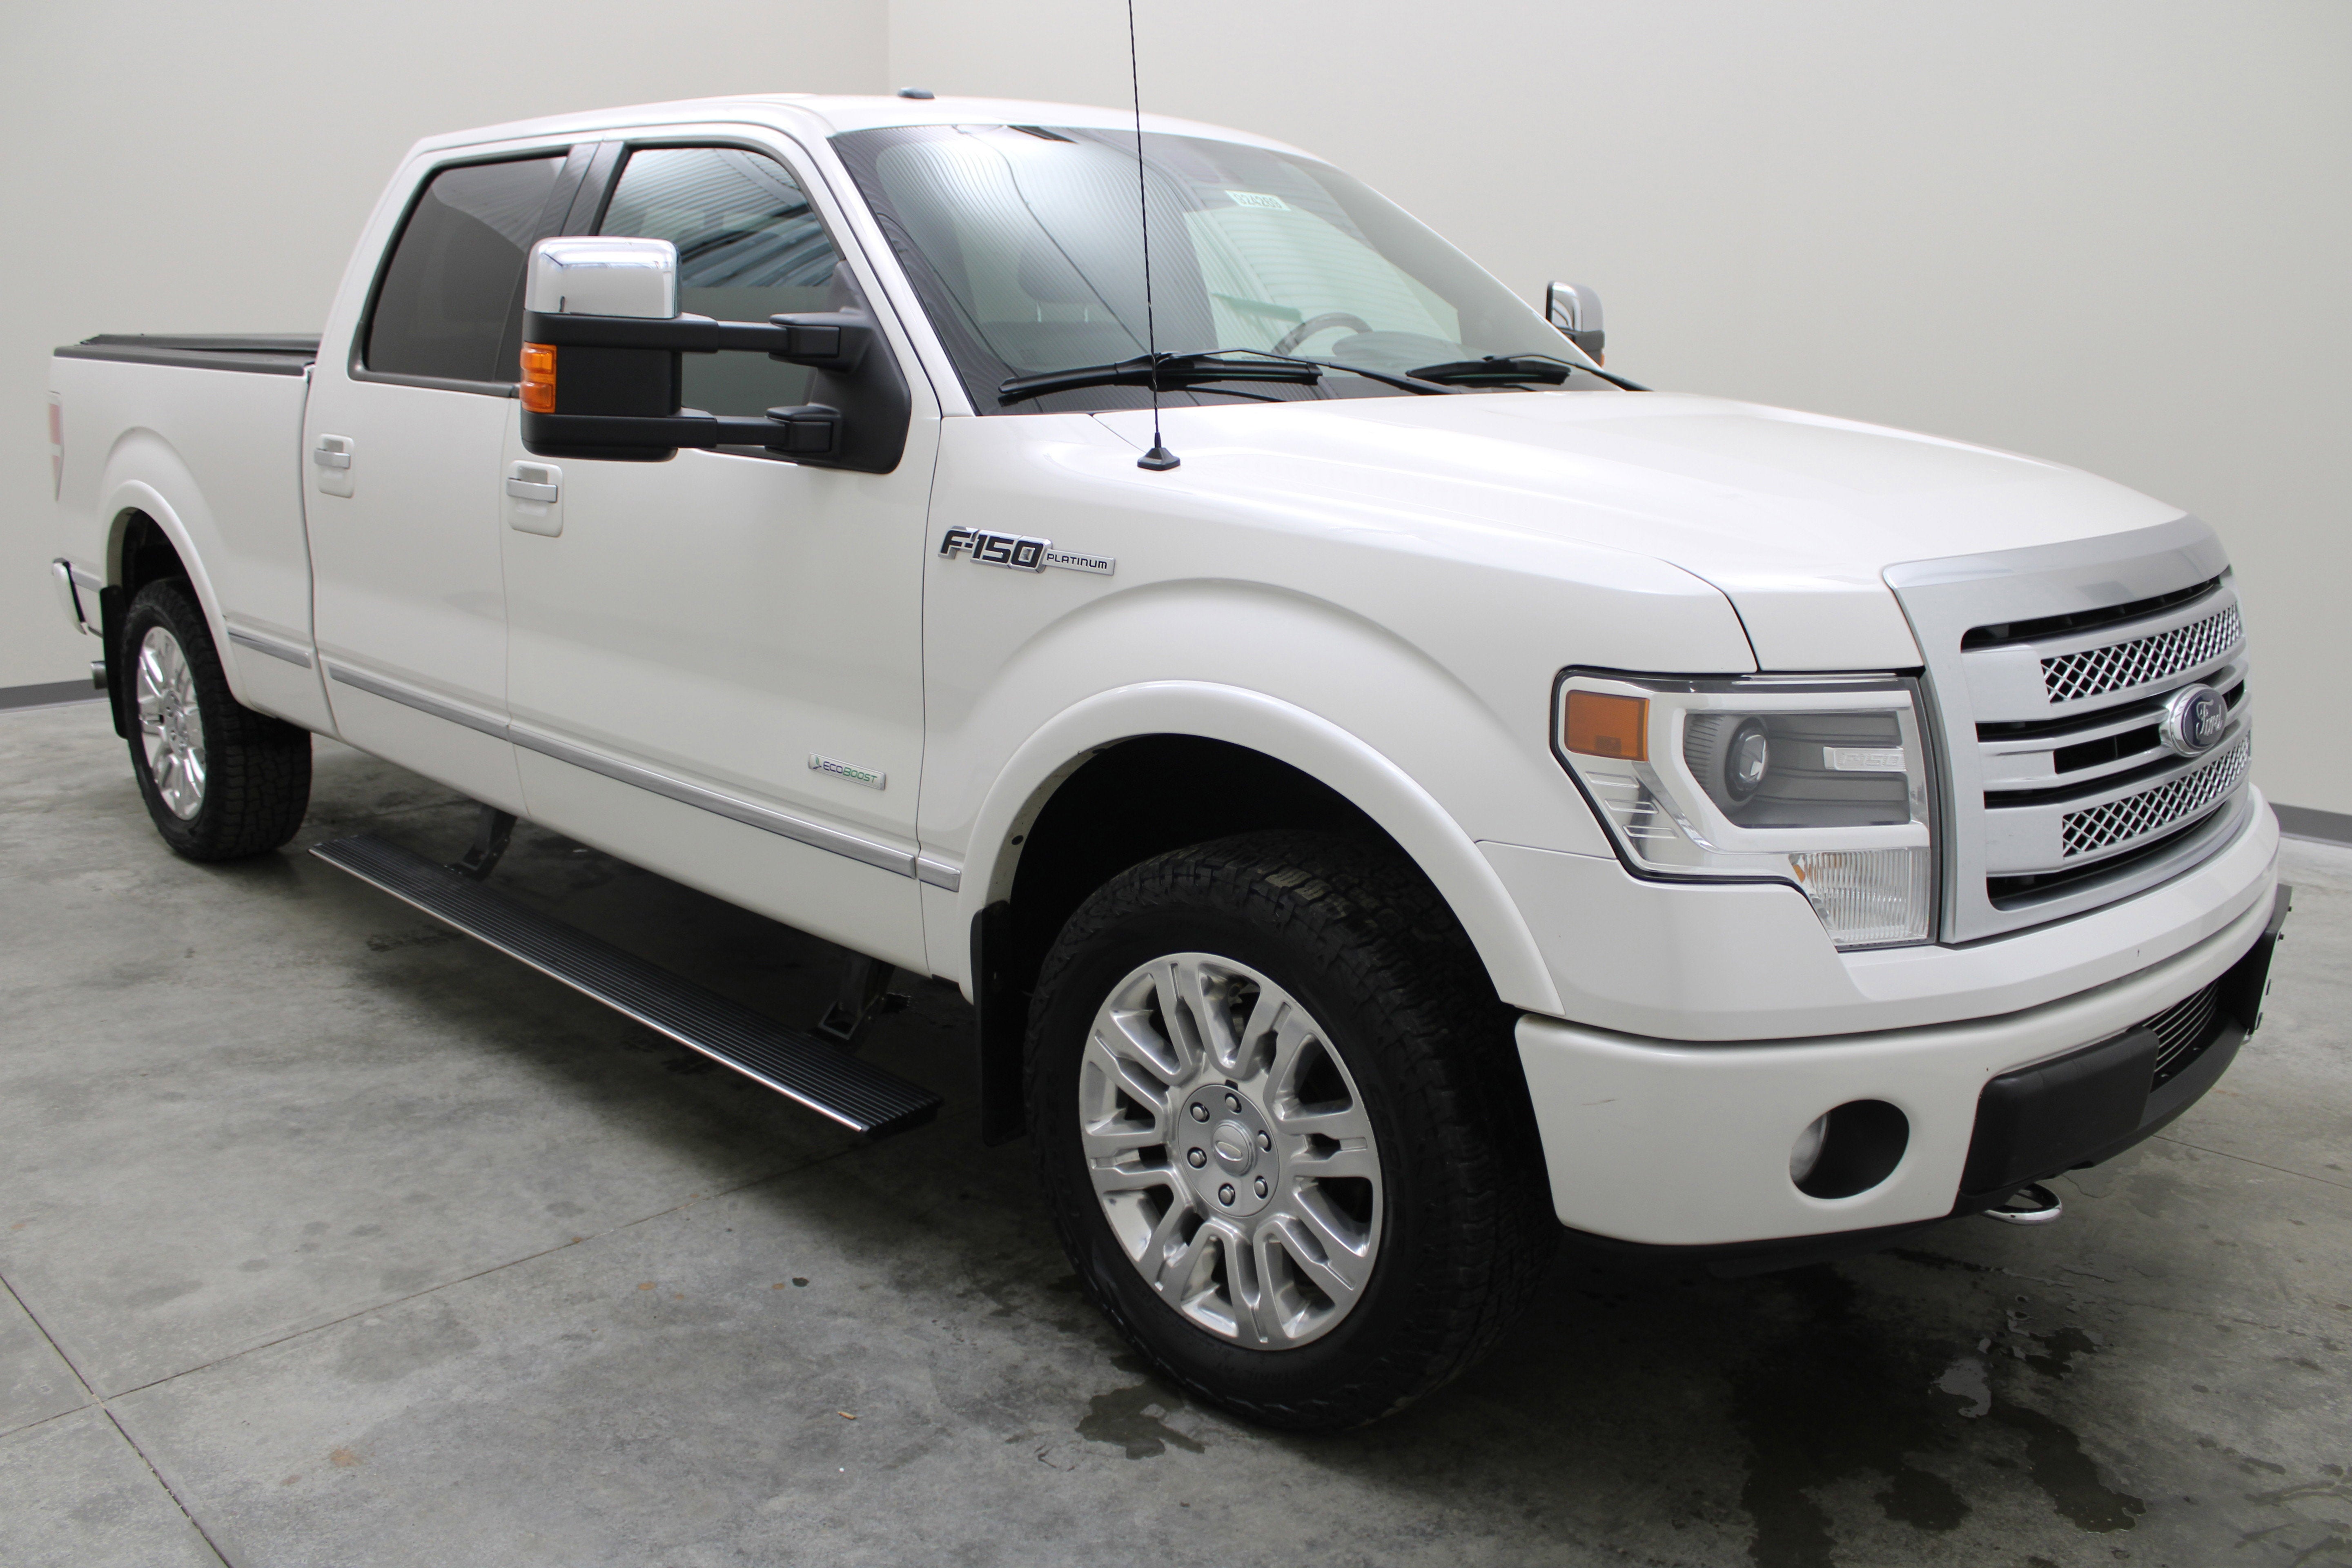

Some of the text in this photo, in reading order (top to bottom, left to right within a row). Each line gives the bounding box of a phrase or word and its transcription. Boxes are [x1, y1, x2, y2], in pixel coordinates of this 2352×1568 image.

[938, 526, 1108, 572] F-150 PLATINUM
[2195, 698, 2223, 740] Ford
[823, 761, 878, 783] ECOBOOST
